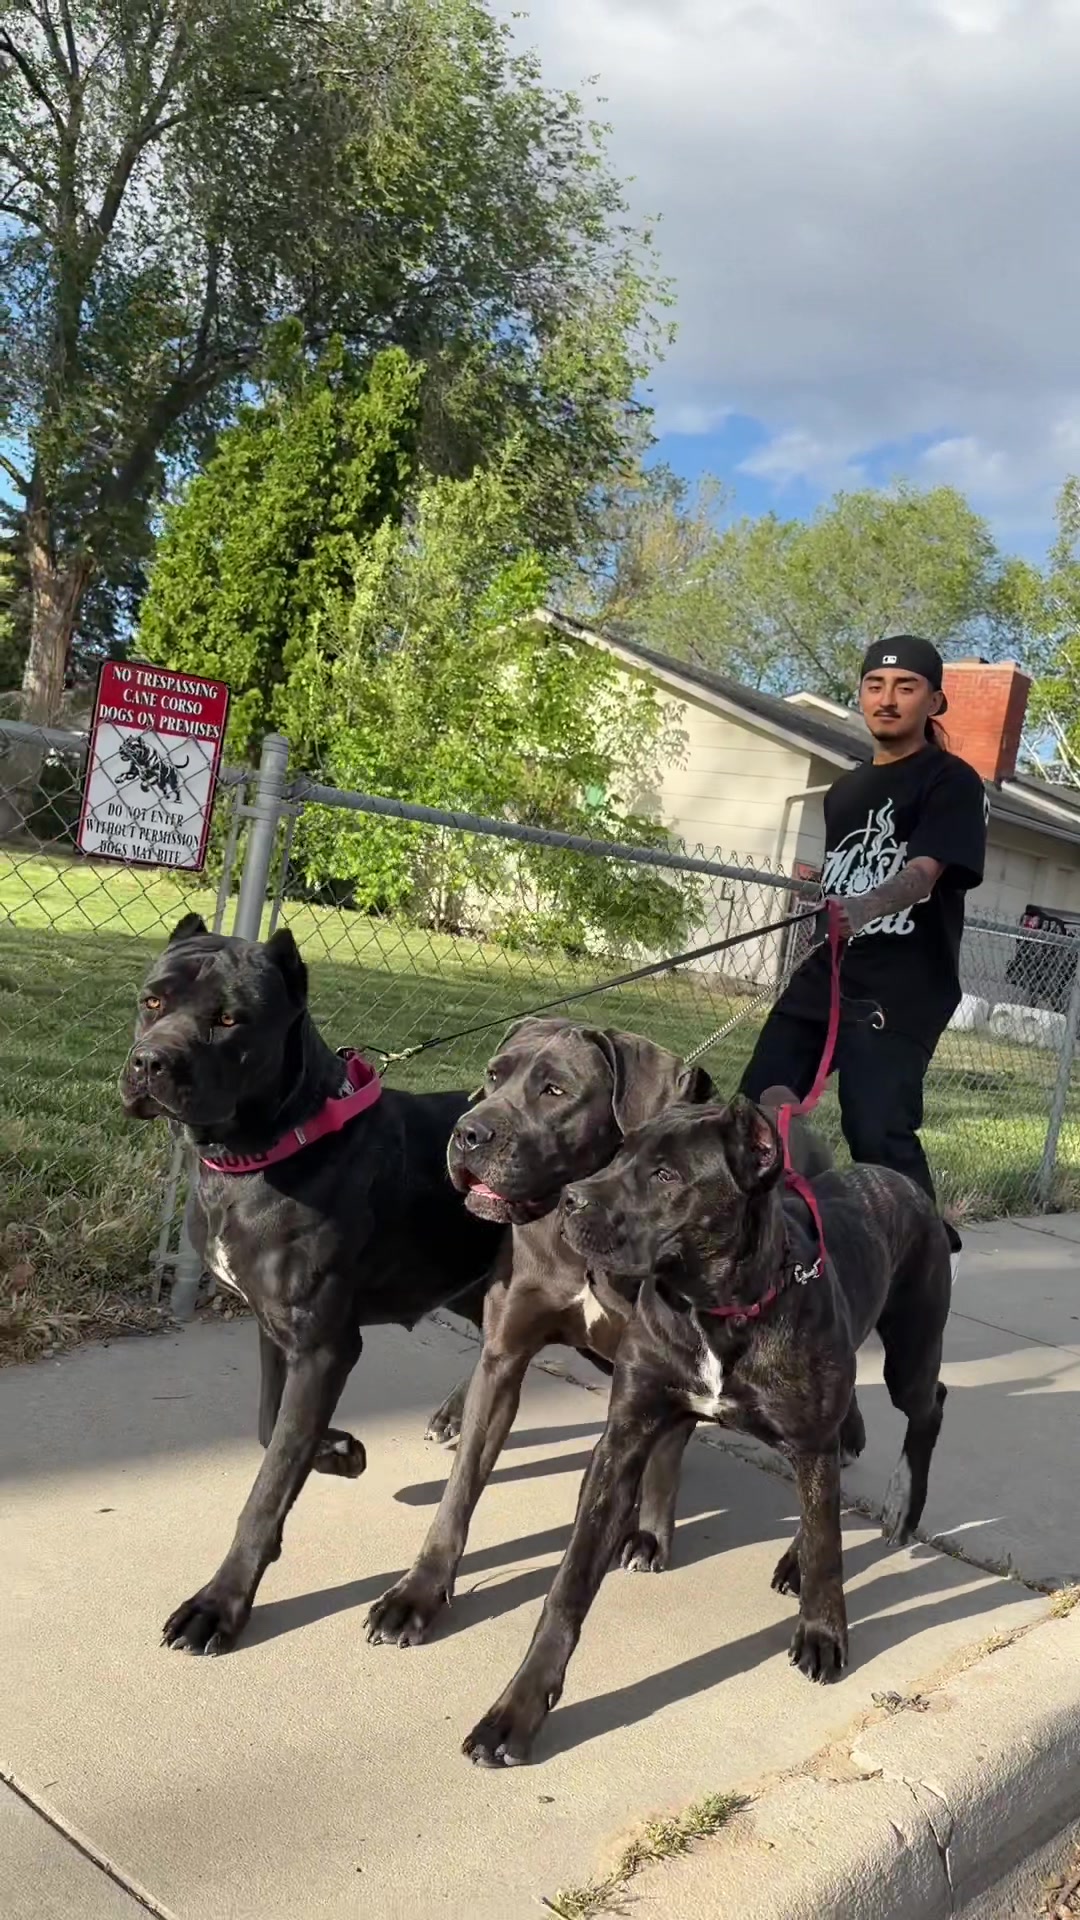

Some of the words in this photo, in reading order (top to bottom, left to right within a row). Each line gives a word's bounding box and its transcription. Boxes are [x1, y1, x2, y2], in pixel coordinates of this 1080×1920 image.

[112, 666, 131, 682] NO
[136, 670, 218, 699] TRESPASSING
[123, 688, 158, 707] CANE
[161, 695, 202, 715] CORSO
[99, 704, 134, 723] DOGS
[137, 712, 156, 727] ON
[159, 715, 220, 739] PREMISES
[108, 803, 122, 817] DO
[126, 805, 147, 821] NOT
[151, 810, 184, 827] ENTER
[86, 818, 136, 838] WITHOUT
[139, 827, 200, 847] PERMISSION
[100, 839, 129, 857] DOGS
[132, 845, 151, 860] MAY
[157, 849, 182, 864] BITE
